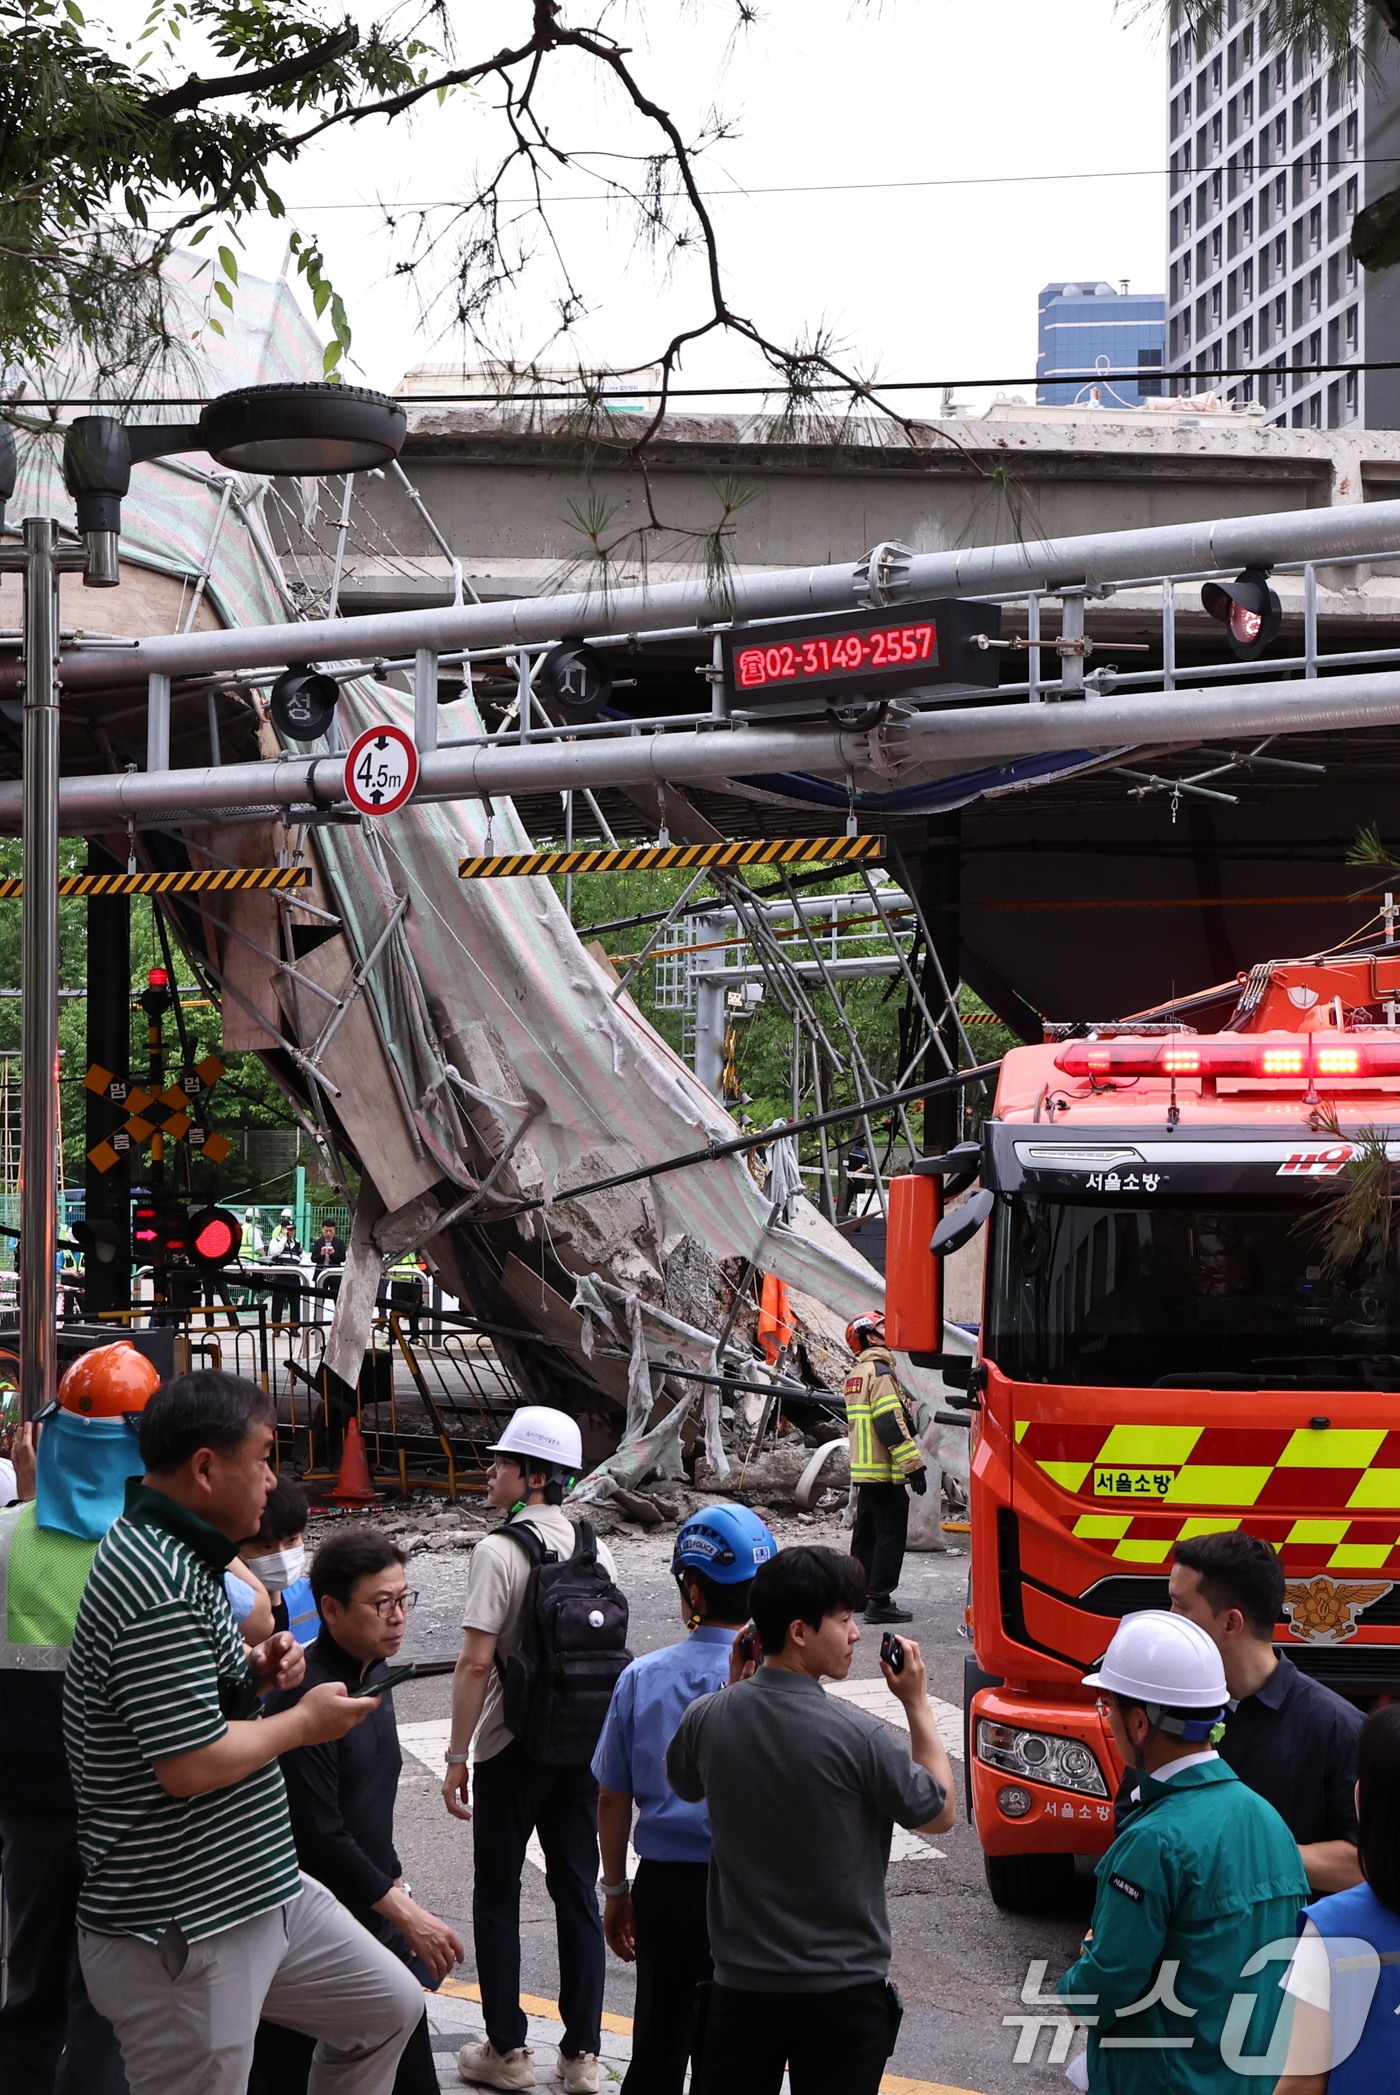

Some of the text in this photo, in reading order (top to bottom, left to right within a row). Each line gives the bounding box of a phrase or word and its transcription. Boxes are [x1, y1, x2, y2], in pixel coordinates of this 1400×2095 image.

[765, 626, 932, 677] 02-3149-2557
[357, 752, 401, 788] 4.5m
[110, 1083, 127, 1099] 멈
[184, 1077, 200, 1093] 멈
[113, 1134, 130, 1150] 춤
[188, 1128, 205, 1144] 춤
[1279, 1144, 1355, 1174] 119
[1085, 1172, 1161, 1192] 서울소방
[1097, 1473, 1172, 1494] 서울소방
[692, 1539, 715, 1555] POLICE
[1044, 1801, 1111, 1821] 서울소방
